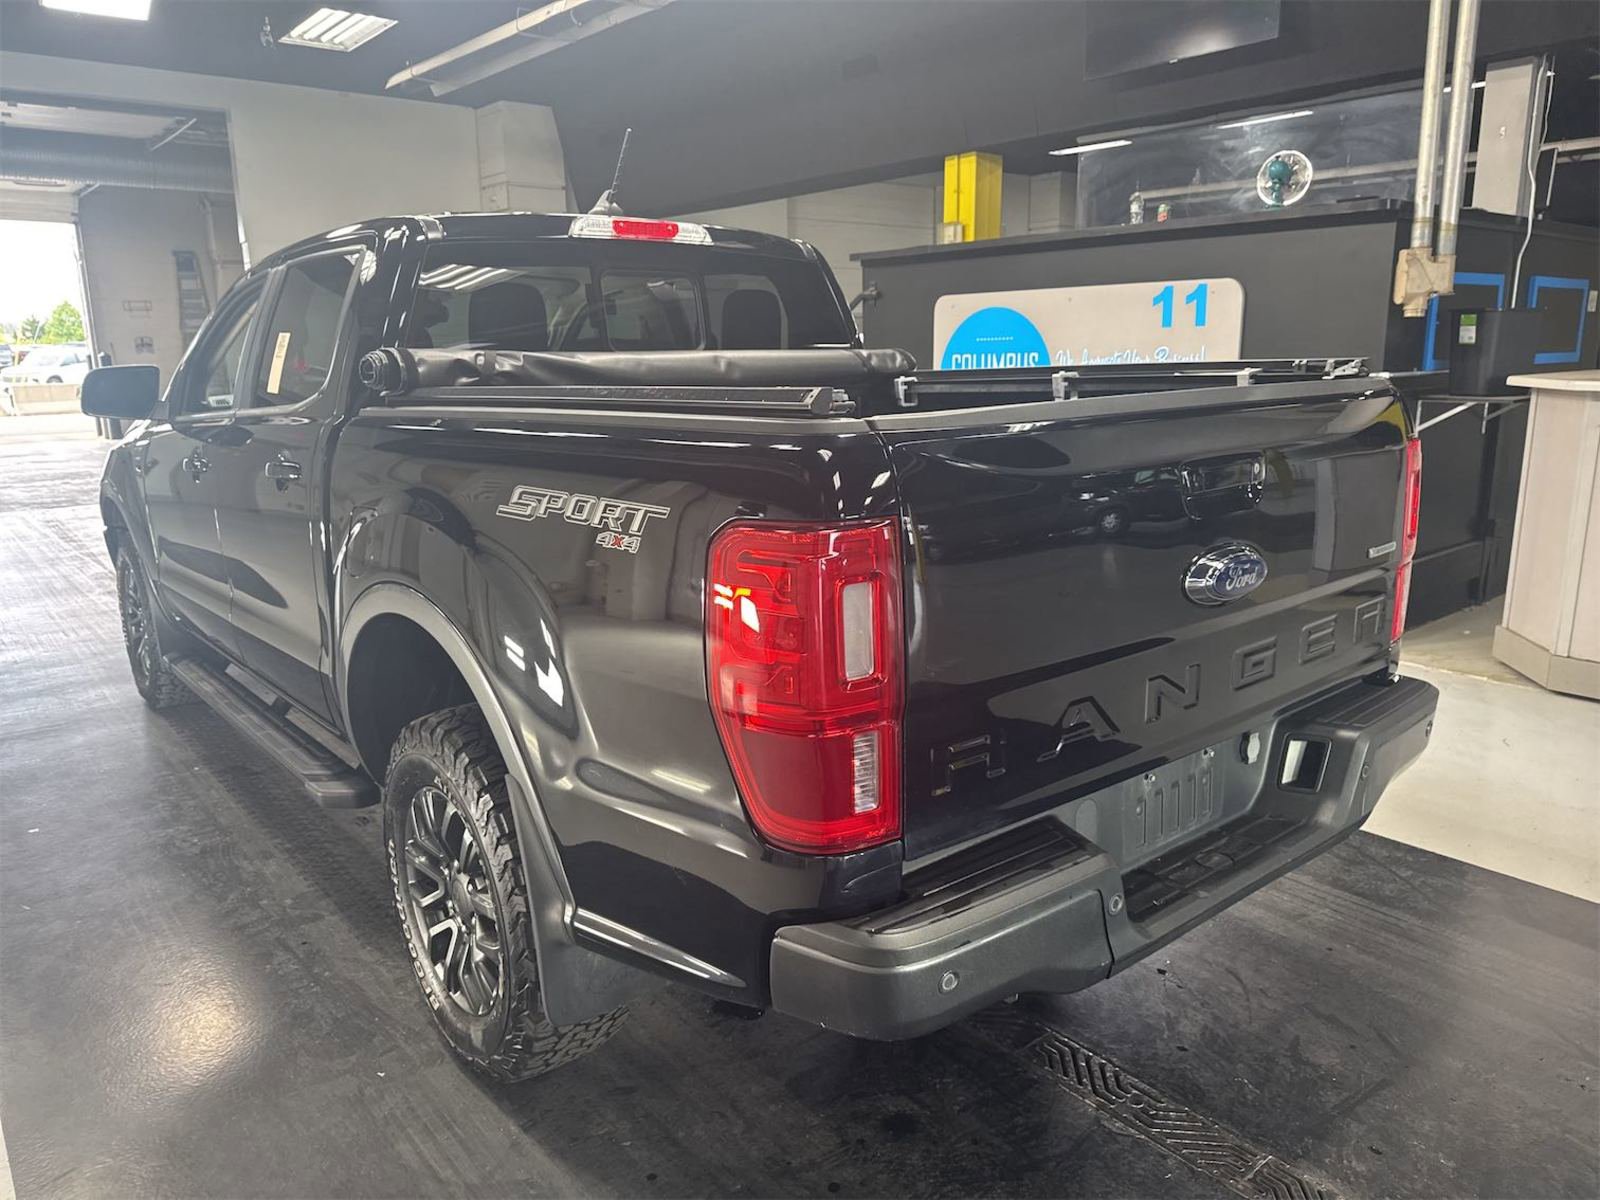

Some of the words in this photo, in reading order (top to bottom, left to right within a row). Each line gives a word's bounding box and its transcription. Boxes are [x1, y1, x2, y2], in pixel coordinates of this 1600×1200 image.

[1152, 283, 1208, 328] 11
[951, 351, 1039, 370] COLUMBUS
[496, 485, 670, 535] SPORT
[1226, 562, 1259, 591] Ford
[930, 595, 1387, 797] RANGER
